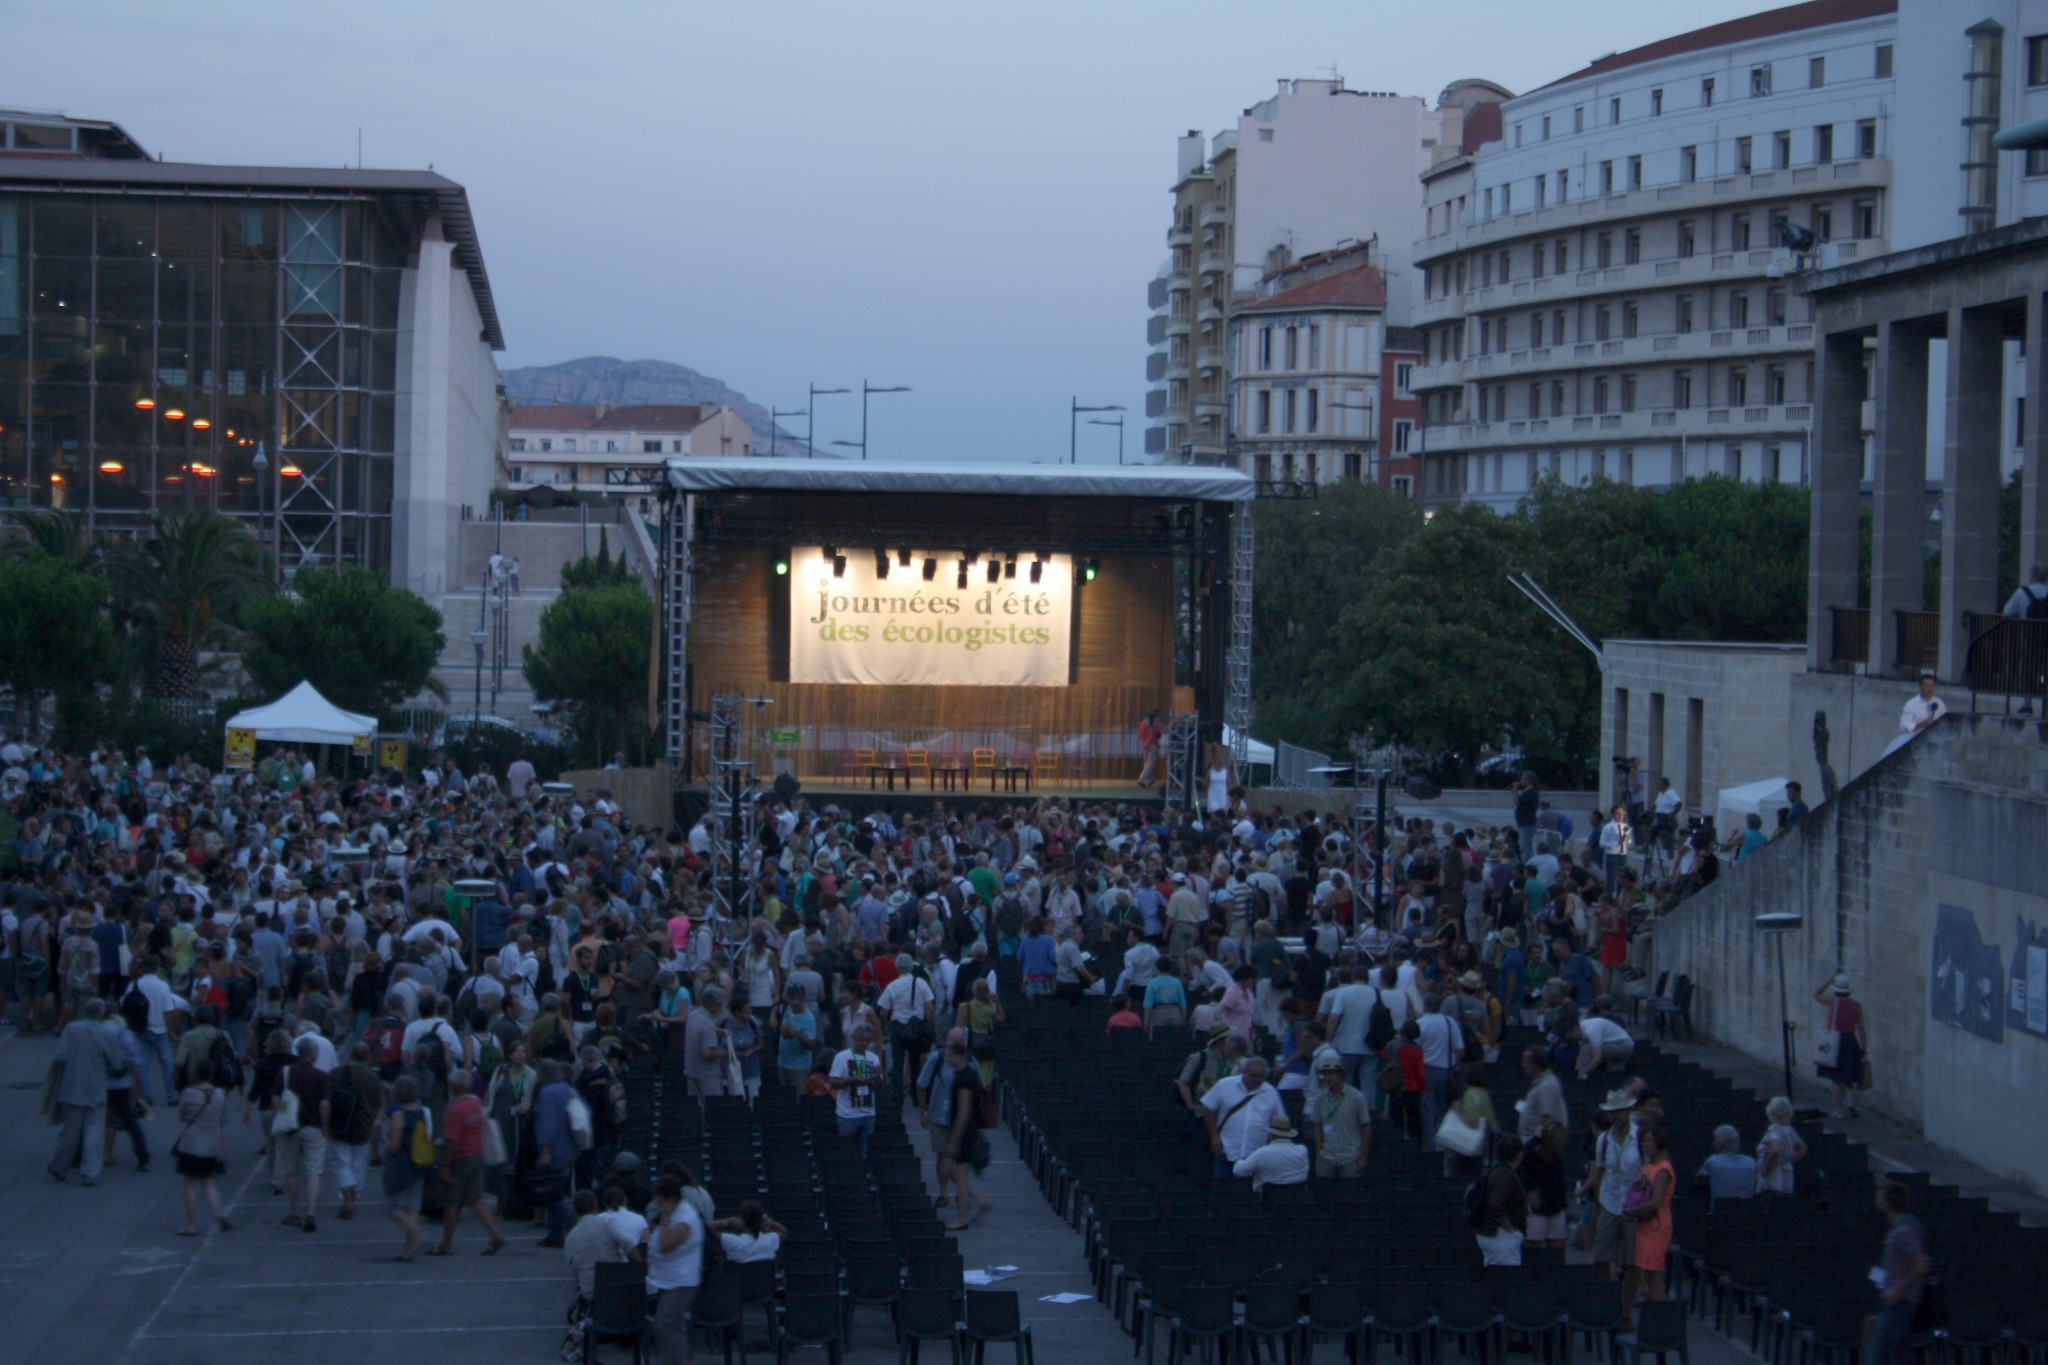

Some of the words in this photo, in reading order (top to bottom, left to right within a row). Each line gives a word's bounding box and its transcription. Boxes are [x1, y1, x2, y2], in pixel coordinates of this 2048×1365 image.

[810, 579, 960, 624] journées
[819, 617, 869, 643] des
[882, 618, 1050, 651] écologistes
